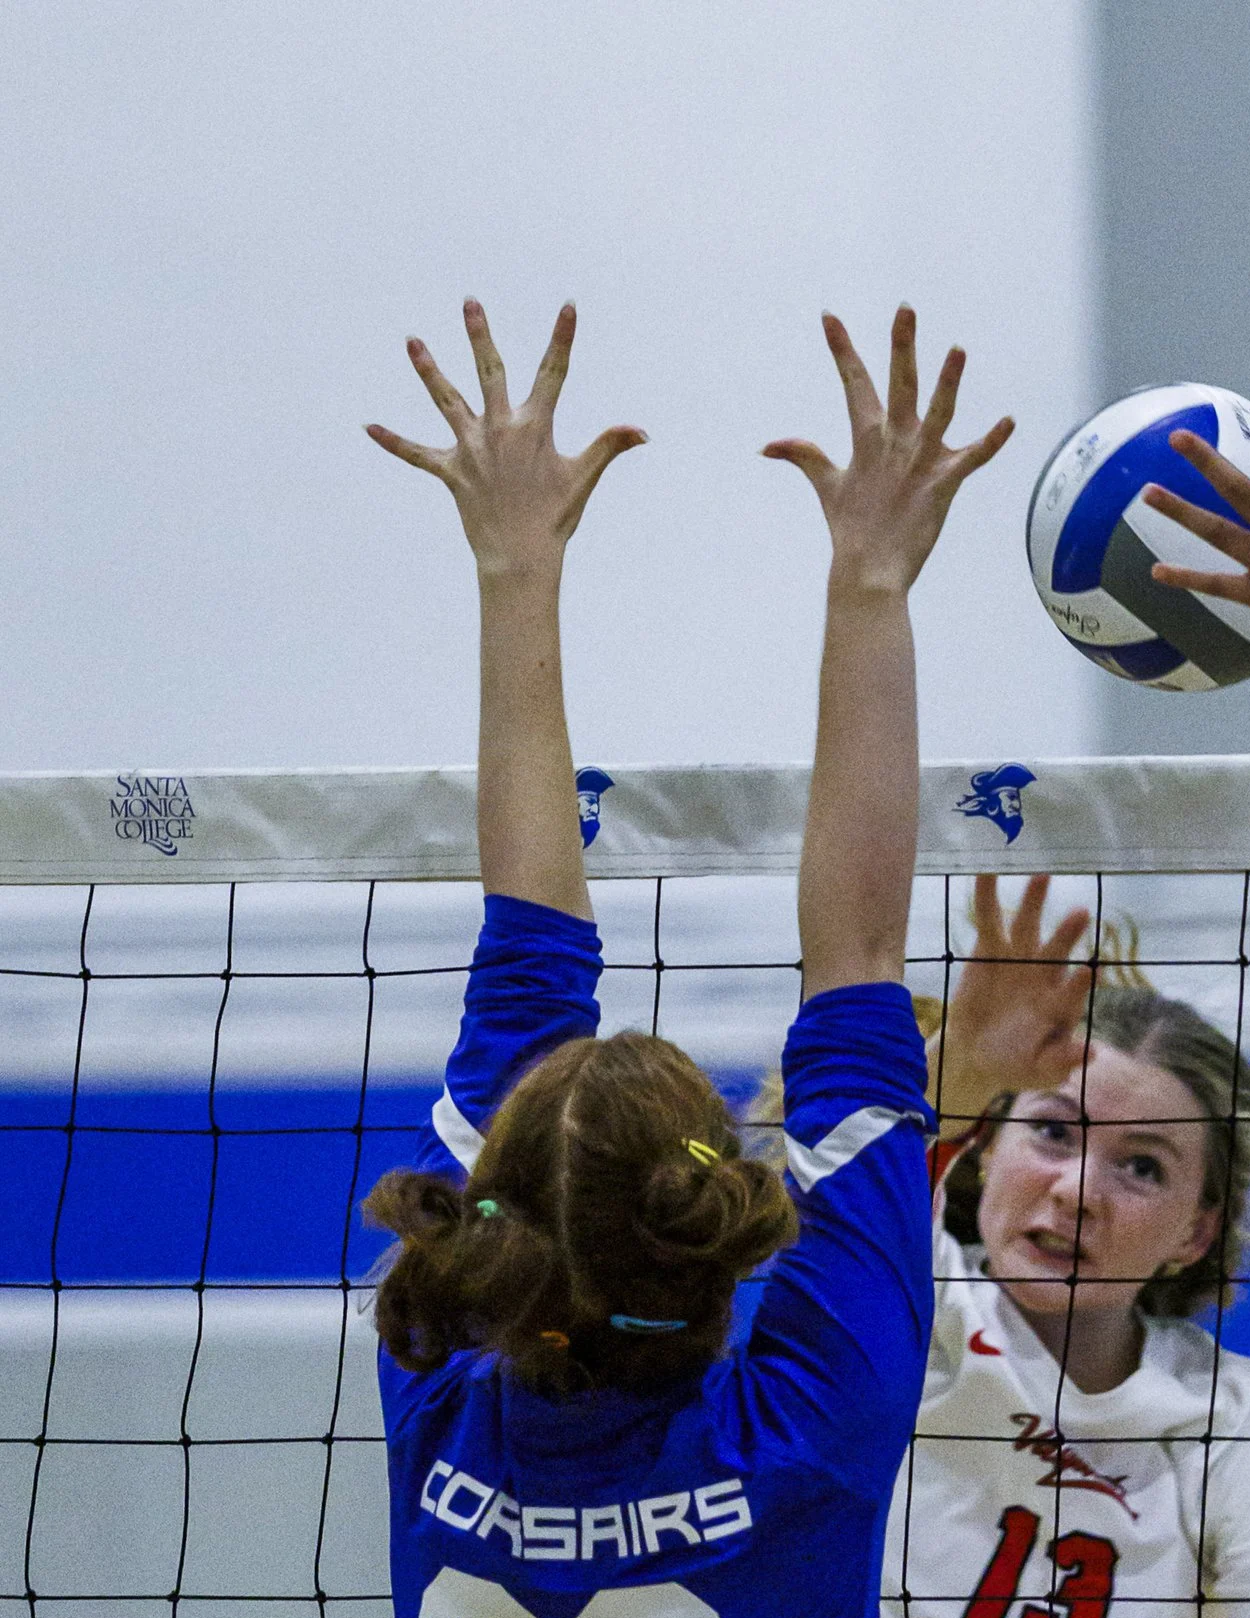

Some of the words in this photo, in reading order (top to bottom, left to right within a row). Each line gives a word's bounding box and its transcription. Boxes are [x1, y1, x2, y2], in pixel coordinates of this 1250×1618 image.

[116, 775, 188, 797] SANTA
[110, 797, 196, 818] MONICA
[115, 819, 194, 856] COLLEGE
[420, 1458, 753, 1561] CORSAIRS
